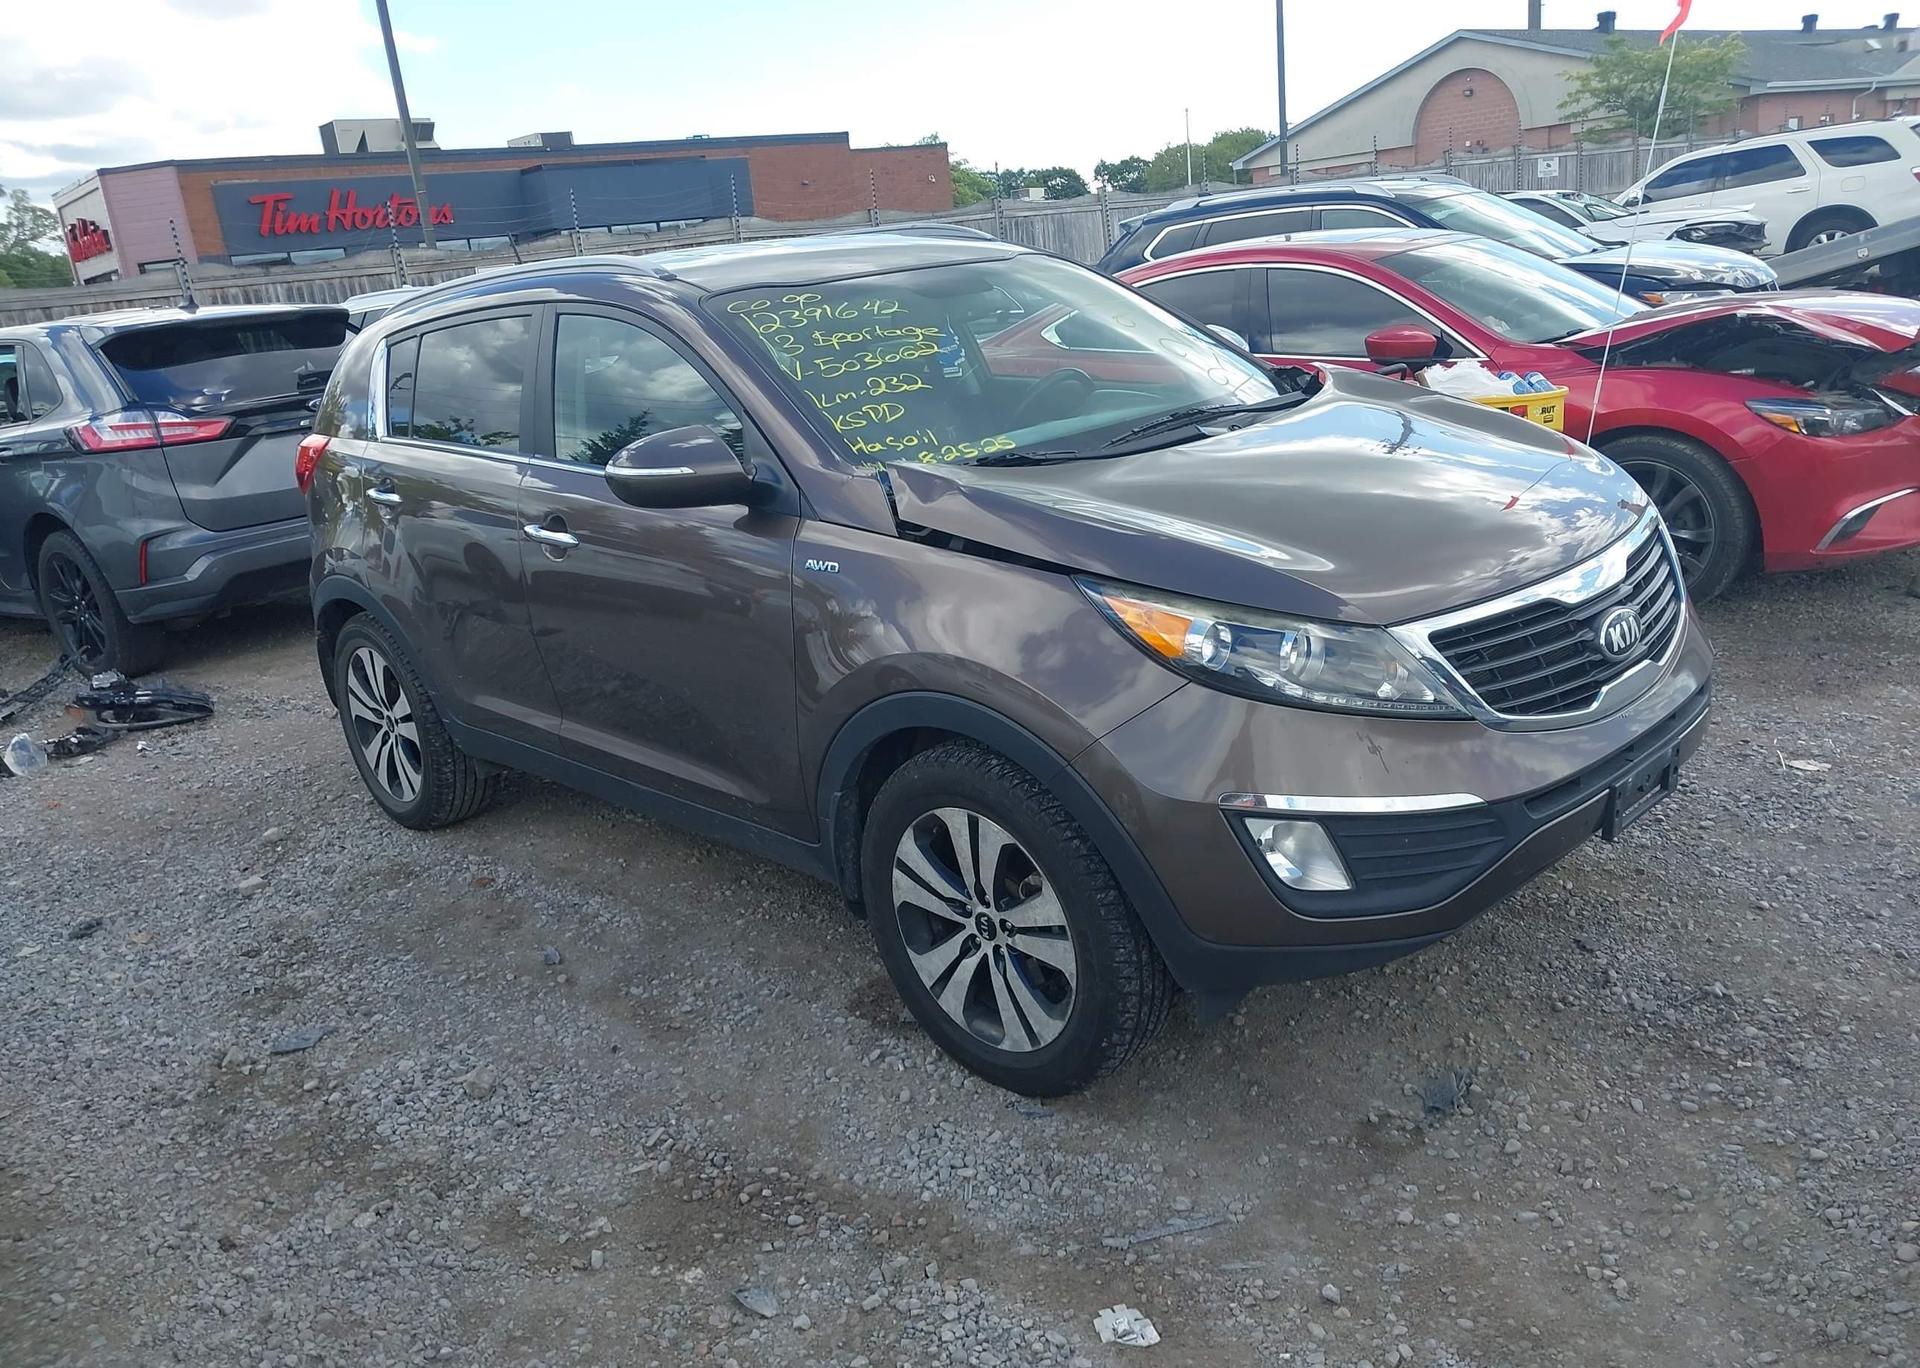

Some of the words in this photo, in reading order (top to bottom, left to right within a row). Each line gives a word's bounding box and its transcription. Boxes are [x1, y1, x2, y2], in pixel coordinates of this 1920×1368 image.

[248, 192, 321, 237] Tim
[804, 558, 840, 573] AWD
[1608, 615, 1640, 652] KIA
